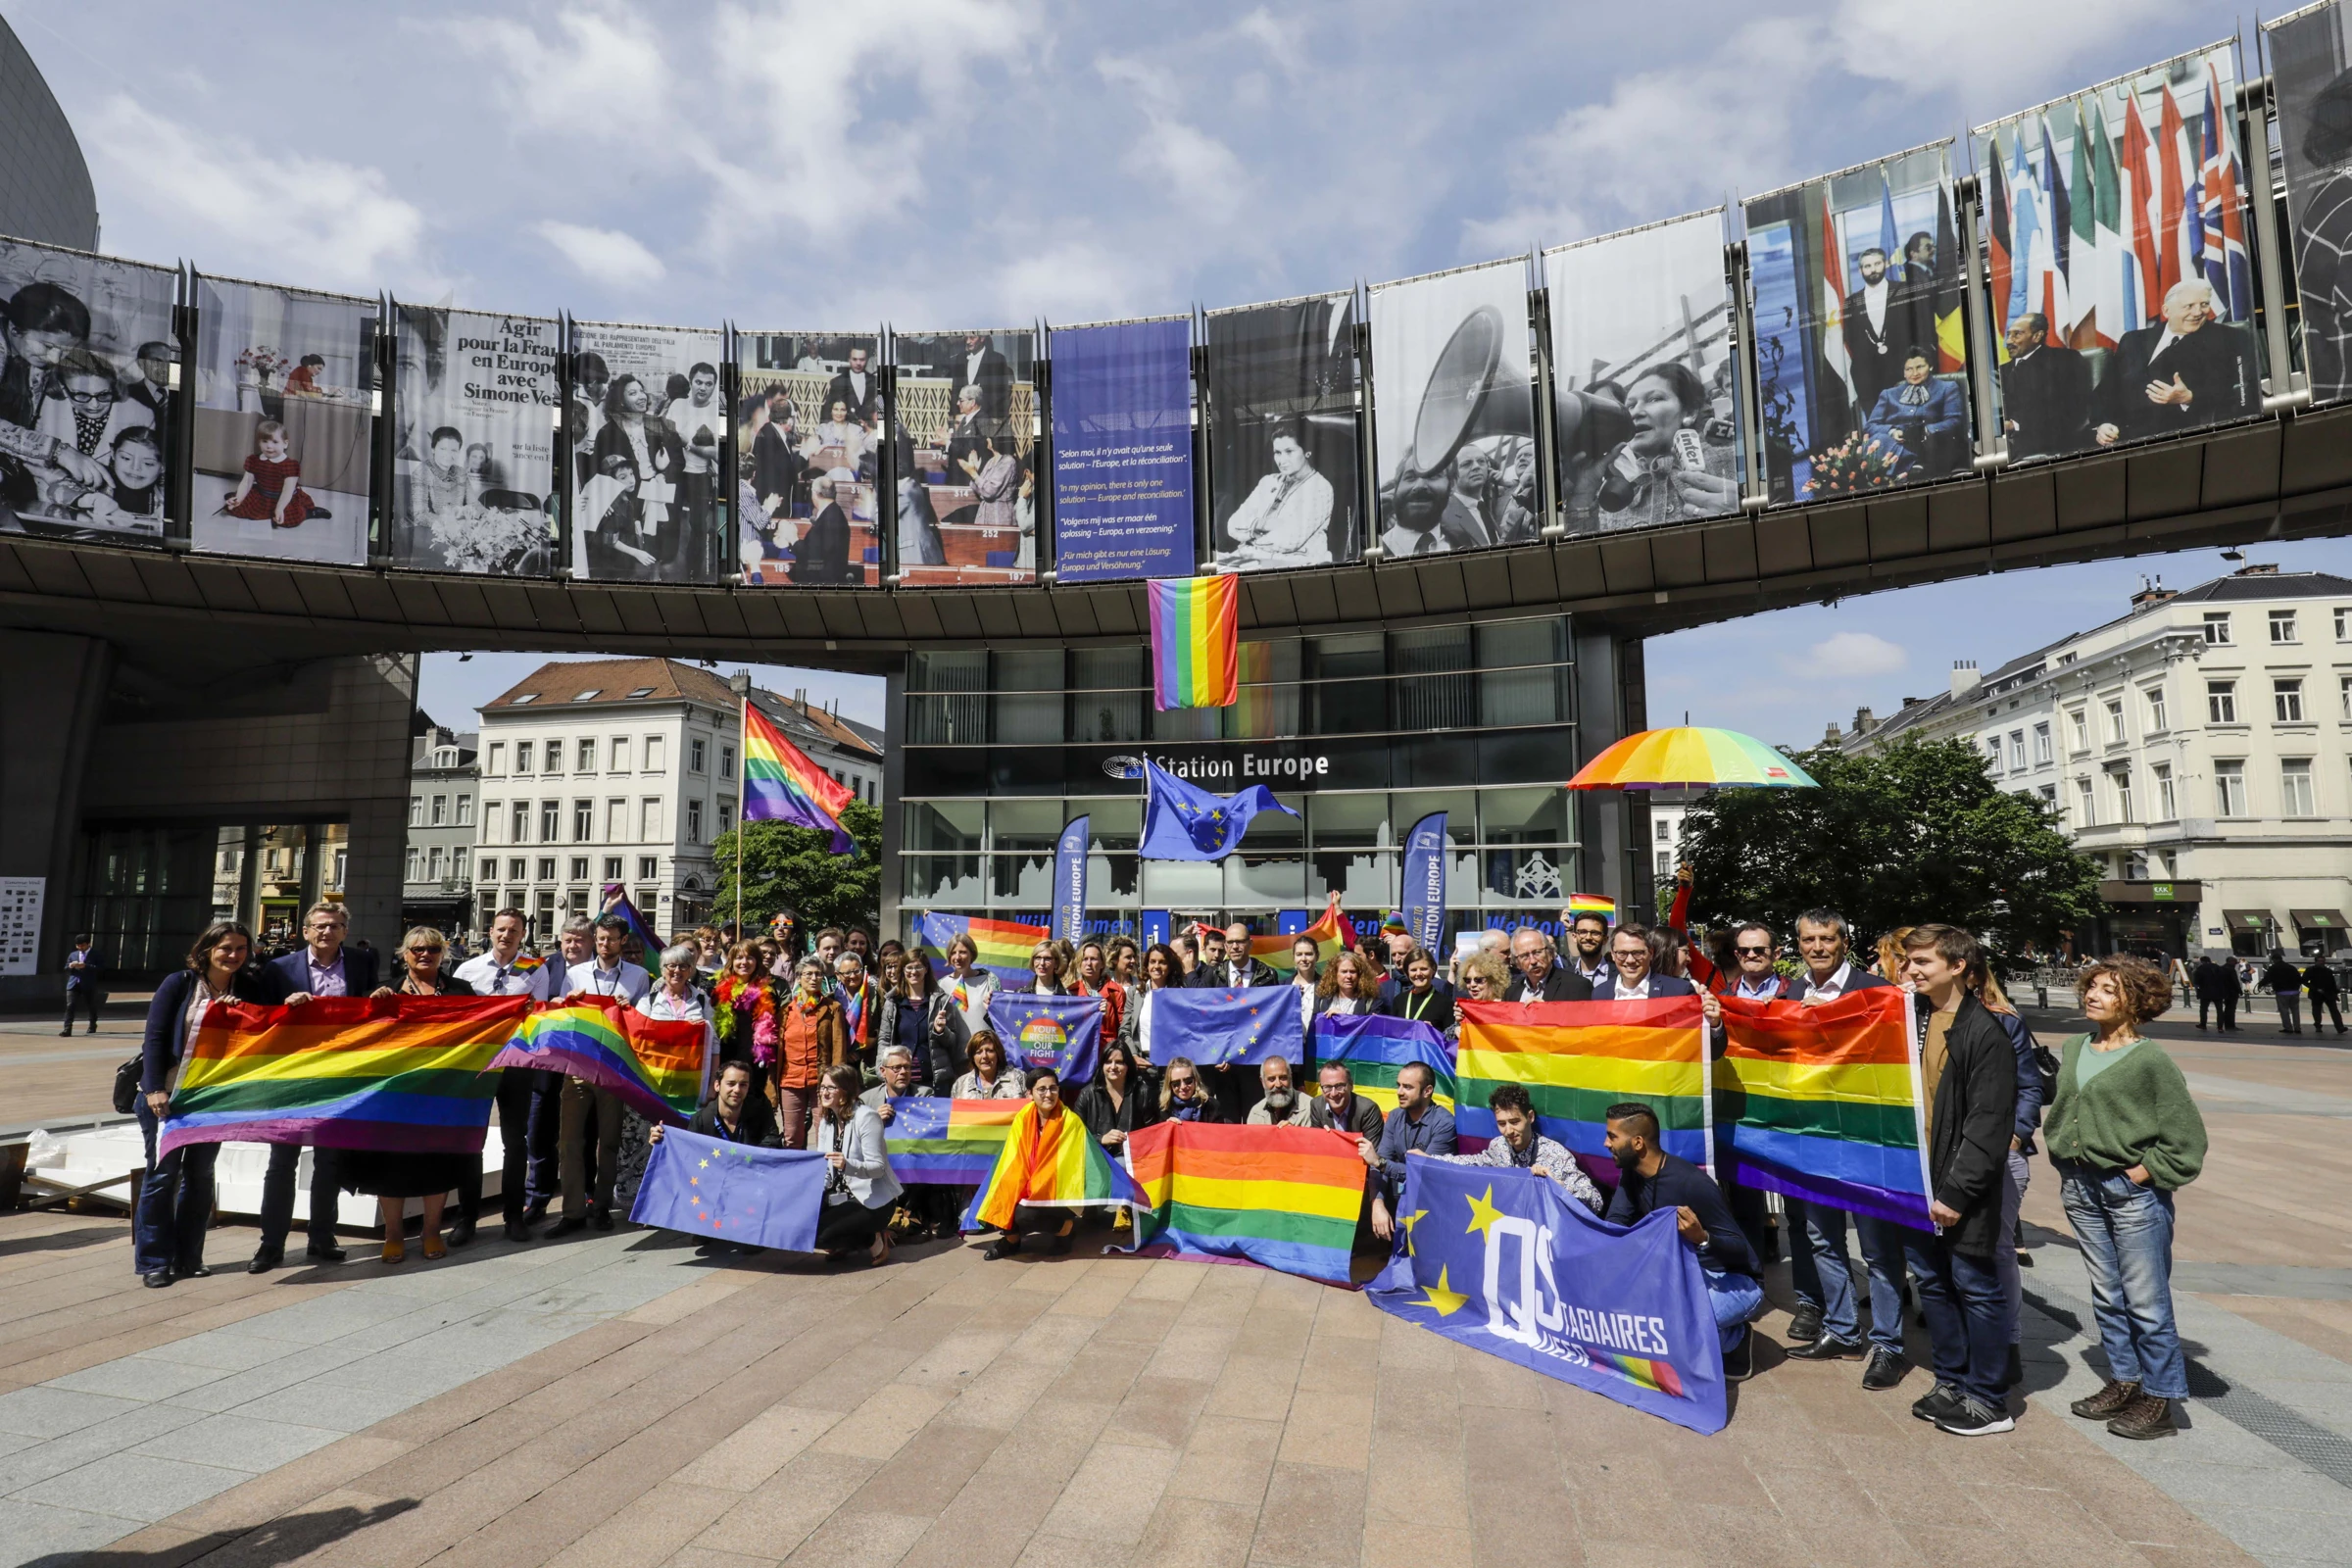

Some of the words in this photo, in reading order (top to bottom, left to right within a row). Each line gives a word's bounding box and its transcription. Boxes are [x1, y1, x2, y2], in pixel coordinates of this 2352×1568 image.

[499, 319, 542, 338] Agir
[458, 337, 500, 351] pour
[503, 337, 518, 353] la
[602, 341, 634, 350] PARLAMENTO
[471, 356, 493, 368] en
[497, 373, 537, 388] avec
[464, 382, 529, 404] Simone
[1080, 449, 1096, 458] moi,
[1112, 445, 1130, 455] avait
[1155, 443, 1173, 452] seule
[1058, 461, 1085, 470] solution
[1068, 484, 1080, 493] my
[1080, 482, 1107, 492] opinion,
[1108, 480, 1127, 489] there
[1133, 479, 1149, 489] only
[1059, 496, 1086, 505] solution
[1098, 494, 1121, 503] Europe
[1122, 492, 1137, 501] and
[1090, 515, 1102, 525] mij
[1060, 529, 1092, 539] oplossing
[1099, 527, 1124, 537] Europa,
[1075, 551, 1093, 560] mich
[1093, 550, 1107, 561] gibt
[1129, 548, 1144, 557] eine
[1145, 547, 1171, 558] Lösung:
[1061, 564, 1085, 572] Europa
[1086, 562, 1101, 570] und
[1155, 755, 1234, 778] Station
[1243, 753, 1329, 781] Europe
[1071, 857, 1082, 902] EUROPE
[1428, 855, 1440, 902] EUROPE
[1062, 905, 1070, 914] TO
[1413, 906, 1424, 914] TO
[1032, 1025, 1056, 1034] YOUR
[1029, 1033, 1059, 1043] RIGHTS
[1033, 1042, 1053, 1051] OUR
[1030, 1050, 1055, 1058] FIGHT
